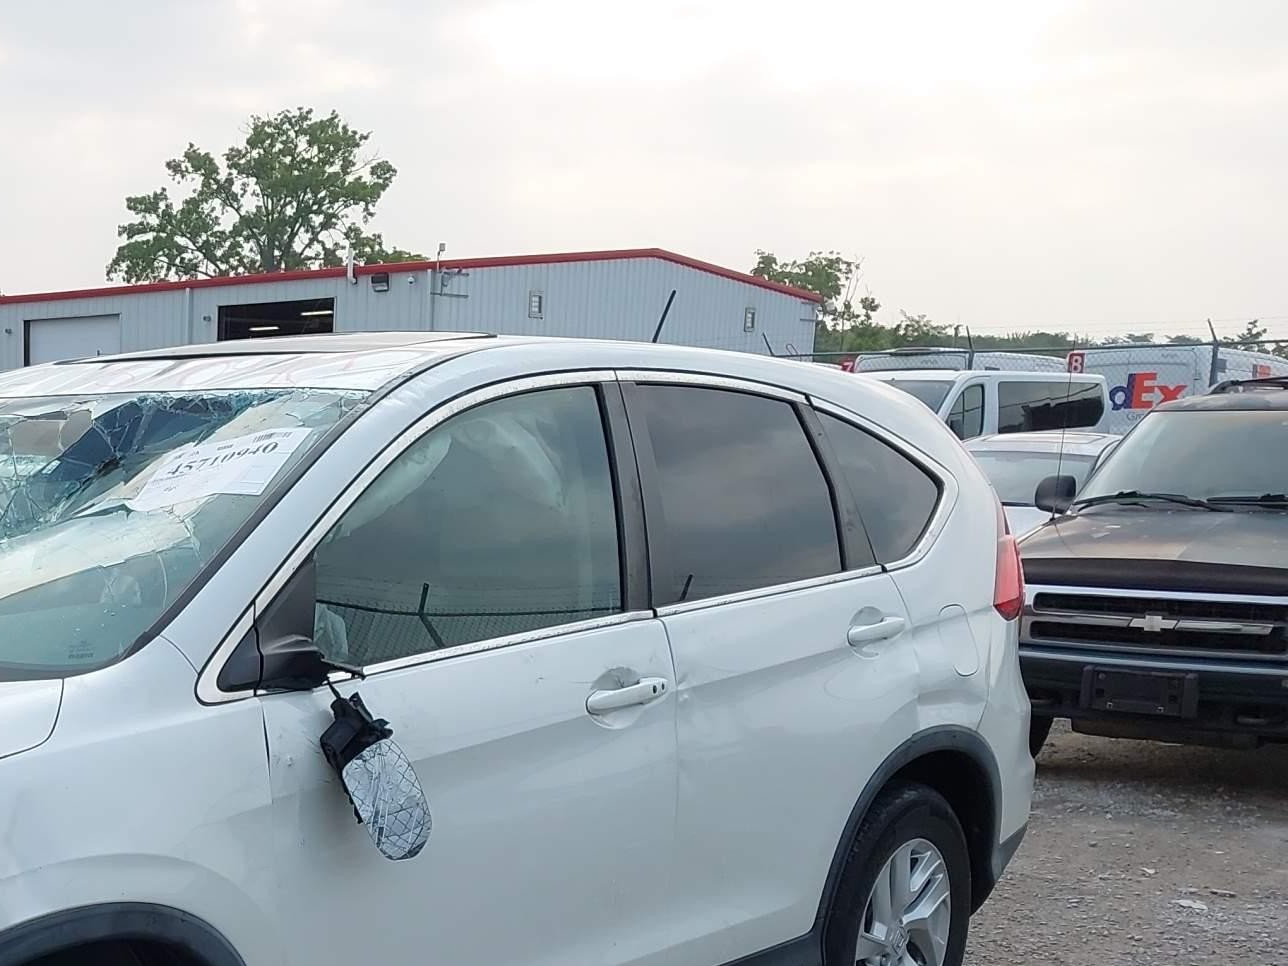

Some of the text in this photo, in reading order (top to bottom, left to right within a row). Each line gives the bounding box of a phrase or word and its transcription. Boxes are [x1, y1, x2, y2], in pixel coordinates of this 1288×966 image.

[1071, 355, 1082, 373] 8
[1109, 372, 1188, 411] dEx
[167, 441, 279, 475] 45710940
